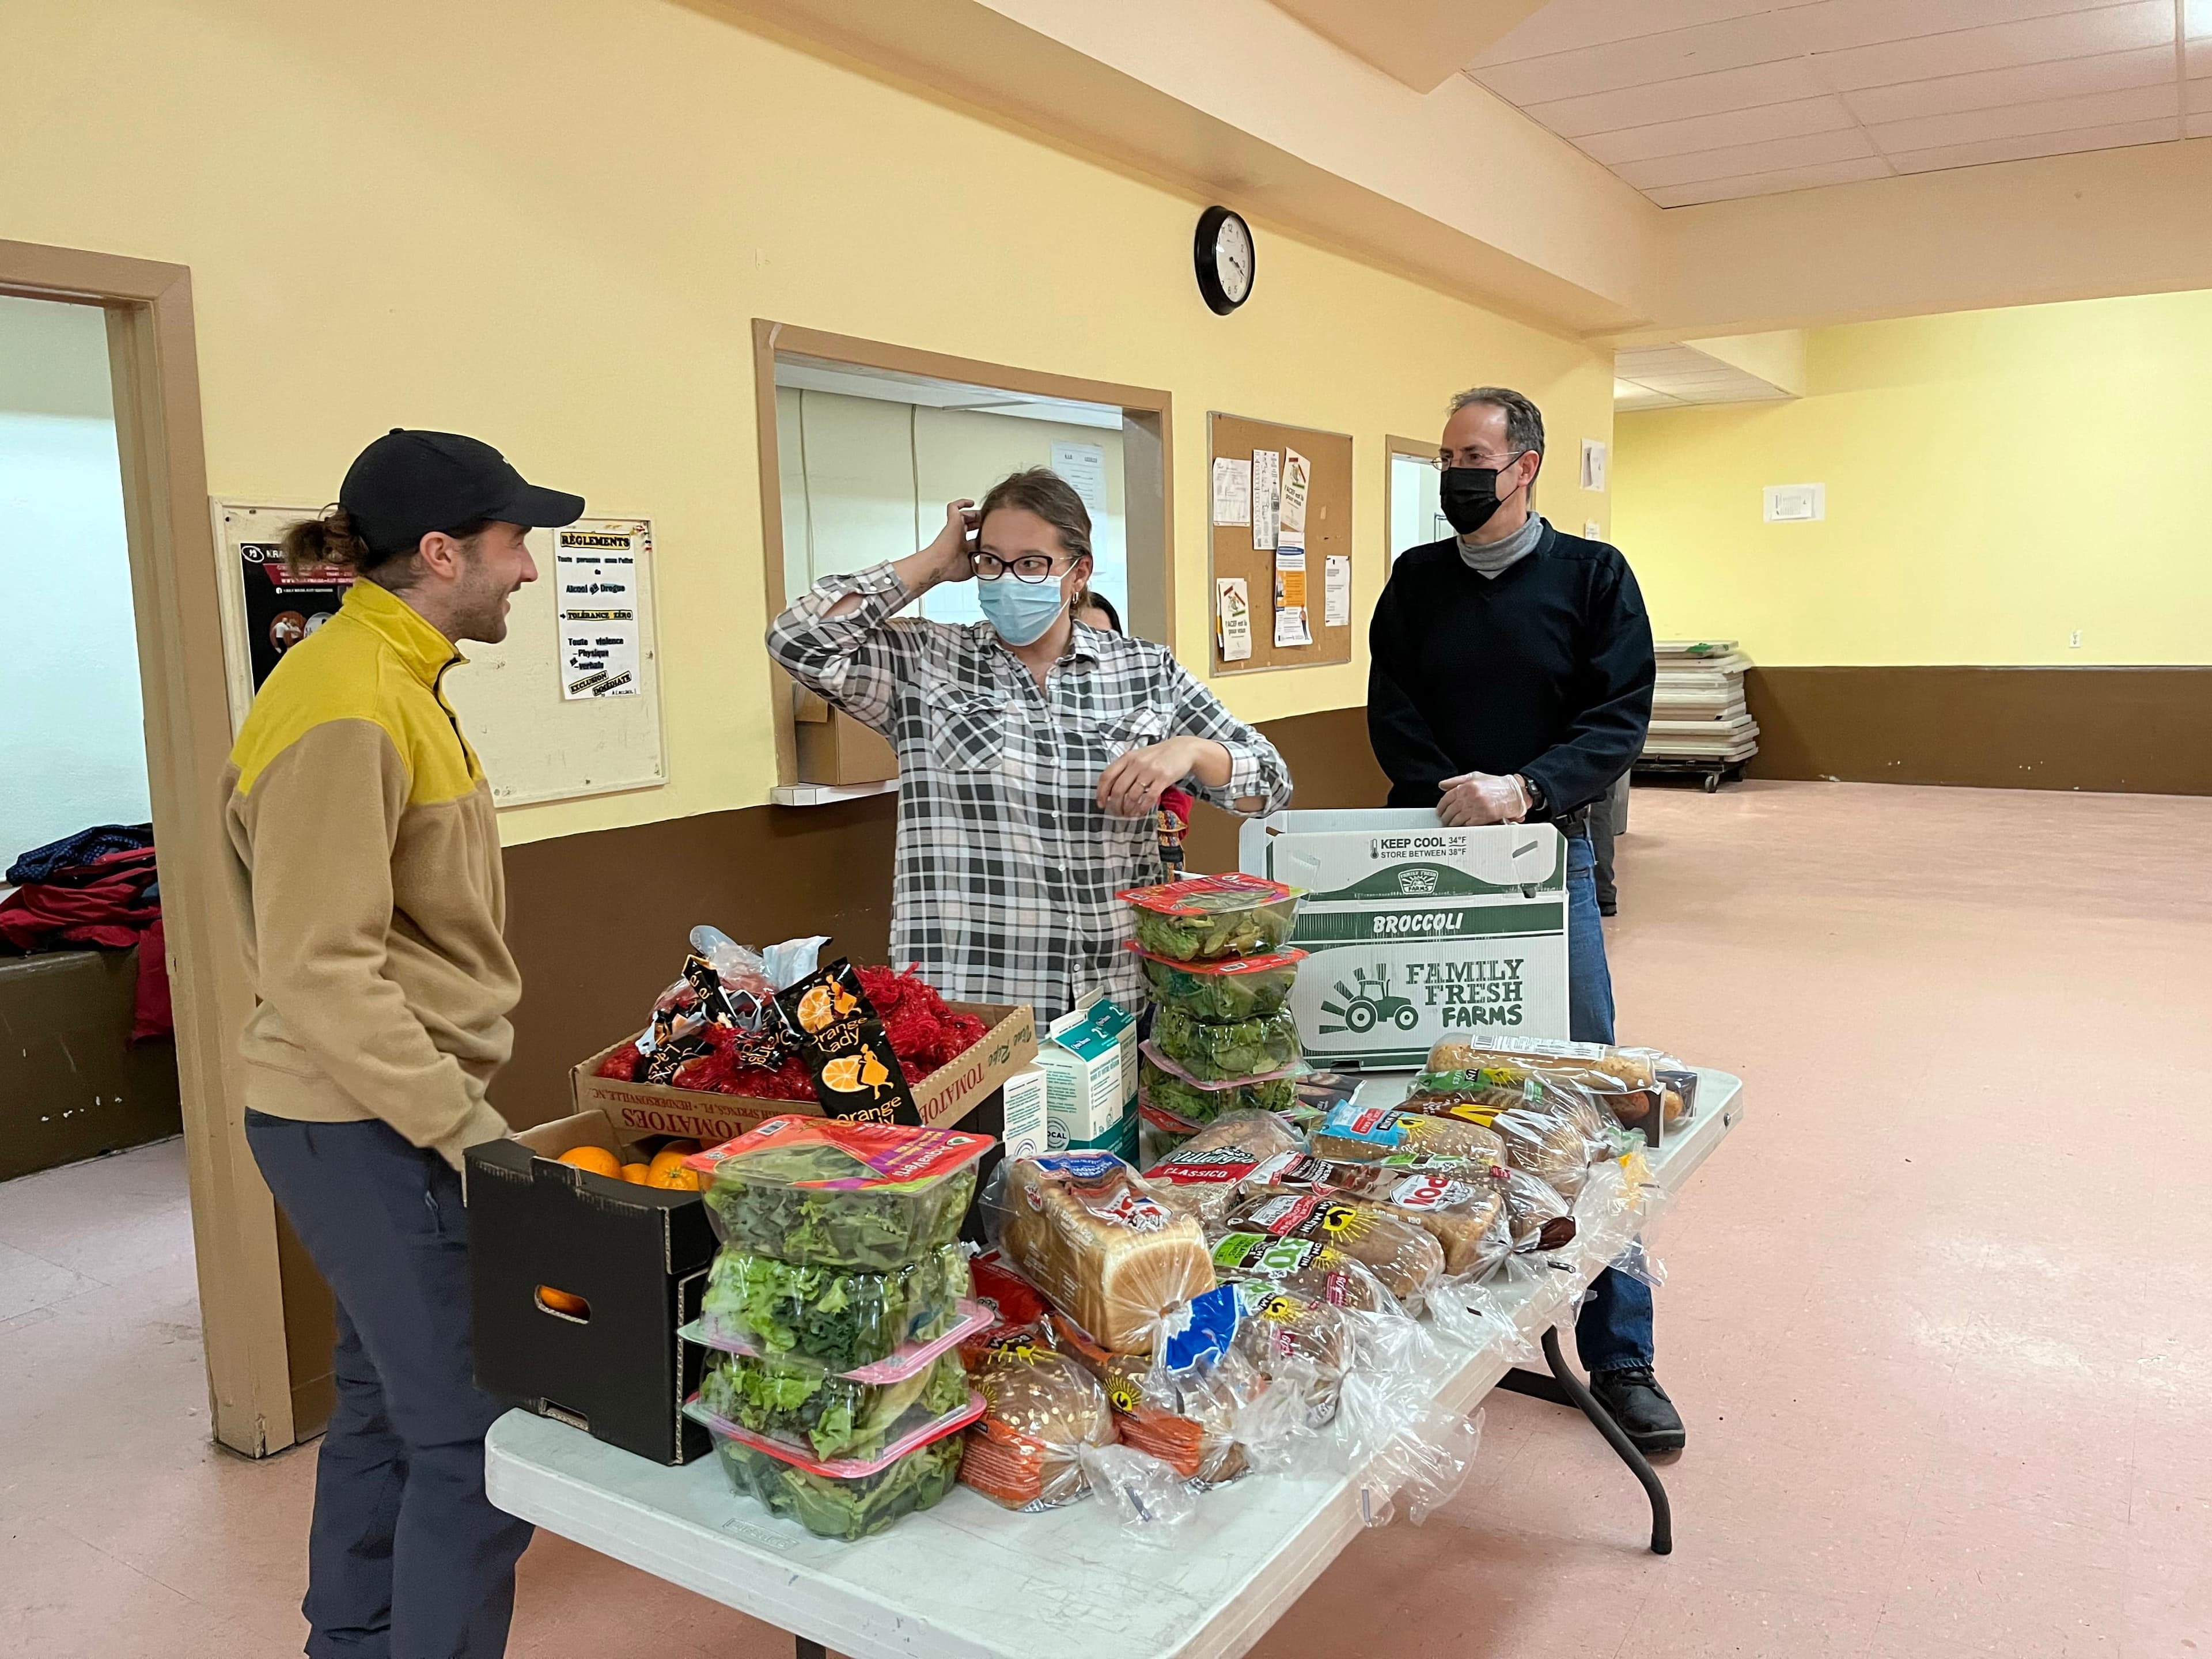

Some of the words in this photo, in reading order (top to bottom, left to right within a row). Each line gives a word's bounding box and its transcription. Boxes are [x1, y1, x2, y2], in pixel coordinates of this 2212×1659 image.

[562, 533, 630, 547] RÈGLEMENTS
[266, 550, 288, 558] KRA
[567, 611, 609, 619] TOLÉRANCE
[613, 611, 631, 619] ZÉRO
[568, 638, 588, 646] Toute
[570, 672, 607, 692] EXCLUSION
[1381, 838, 1411, 849] KEEP
[1414, 837, 1446, 848] COOL
[1409, 850, 1446, 858] BETWEEN
[1373, 912, 1464, 934] BROCCOLI
[1406, 959, 1524, 985] FAMILY
[1425, 981, 1524, 1006] FRESH
[1442, 1004, 1523, 1028] FARMS
[818, 1028, 859, 1052] Lady
[988, 1044, 1010, 1067] Ripe
[919, 1063, 984, 1125] TOMATOE
[621, 1107, 743, 1141] TOMATOES
[1168, 1150, 1256, 1165] Villaggio
[1164, 1168, 1228, 1177] CLASSICO
